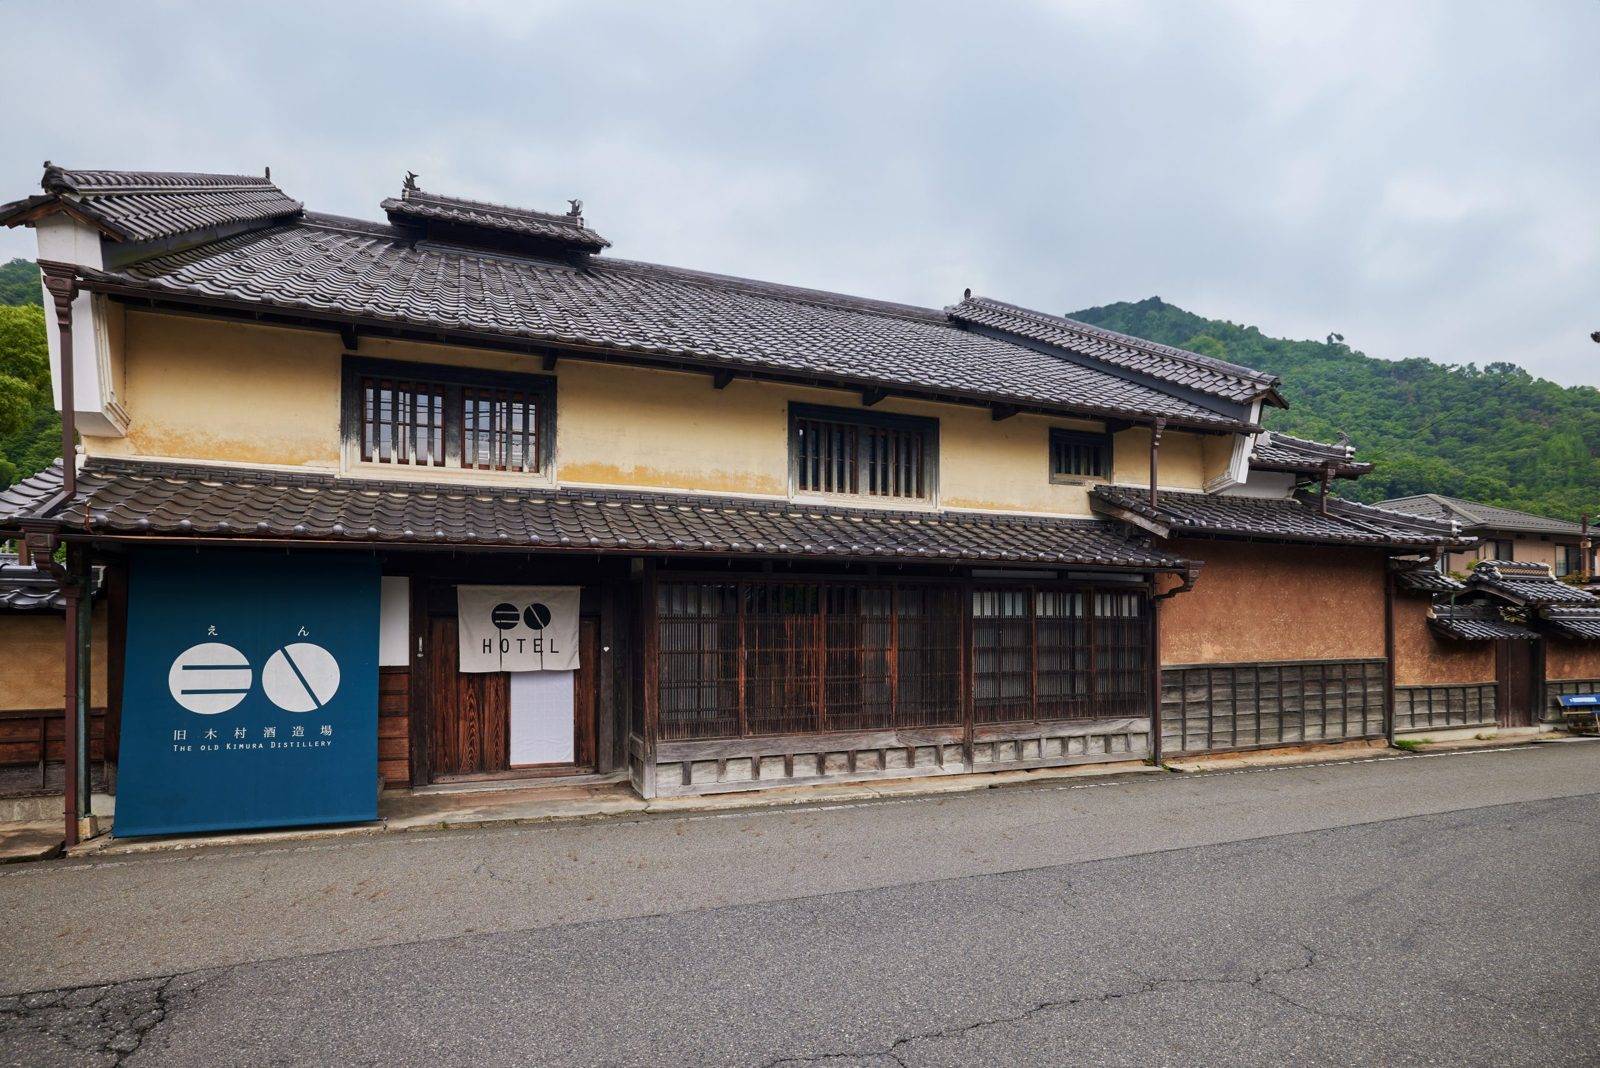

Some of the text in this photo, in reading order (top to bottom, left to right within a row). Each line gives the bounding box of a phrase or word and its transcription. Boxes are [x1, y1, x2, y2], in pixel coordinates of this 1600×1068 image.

[482, 638, 559, 654] HOTEL
[173, 725, 332, 740] 旧木村酒造場
[173, 744, 192, 752] THE
[271, 741, 332, 749] DISTILLERY
